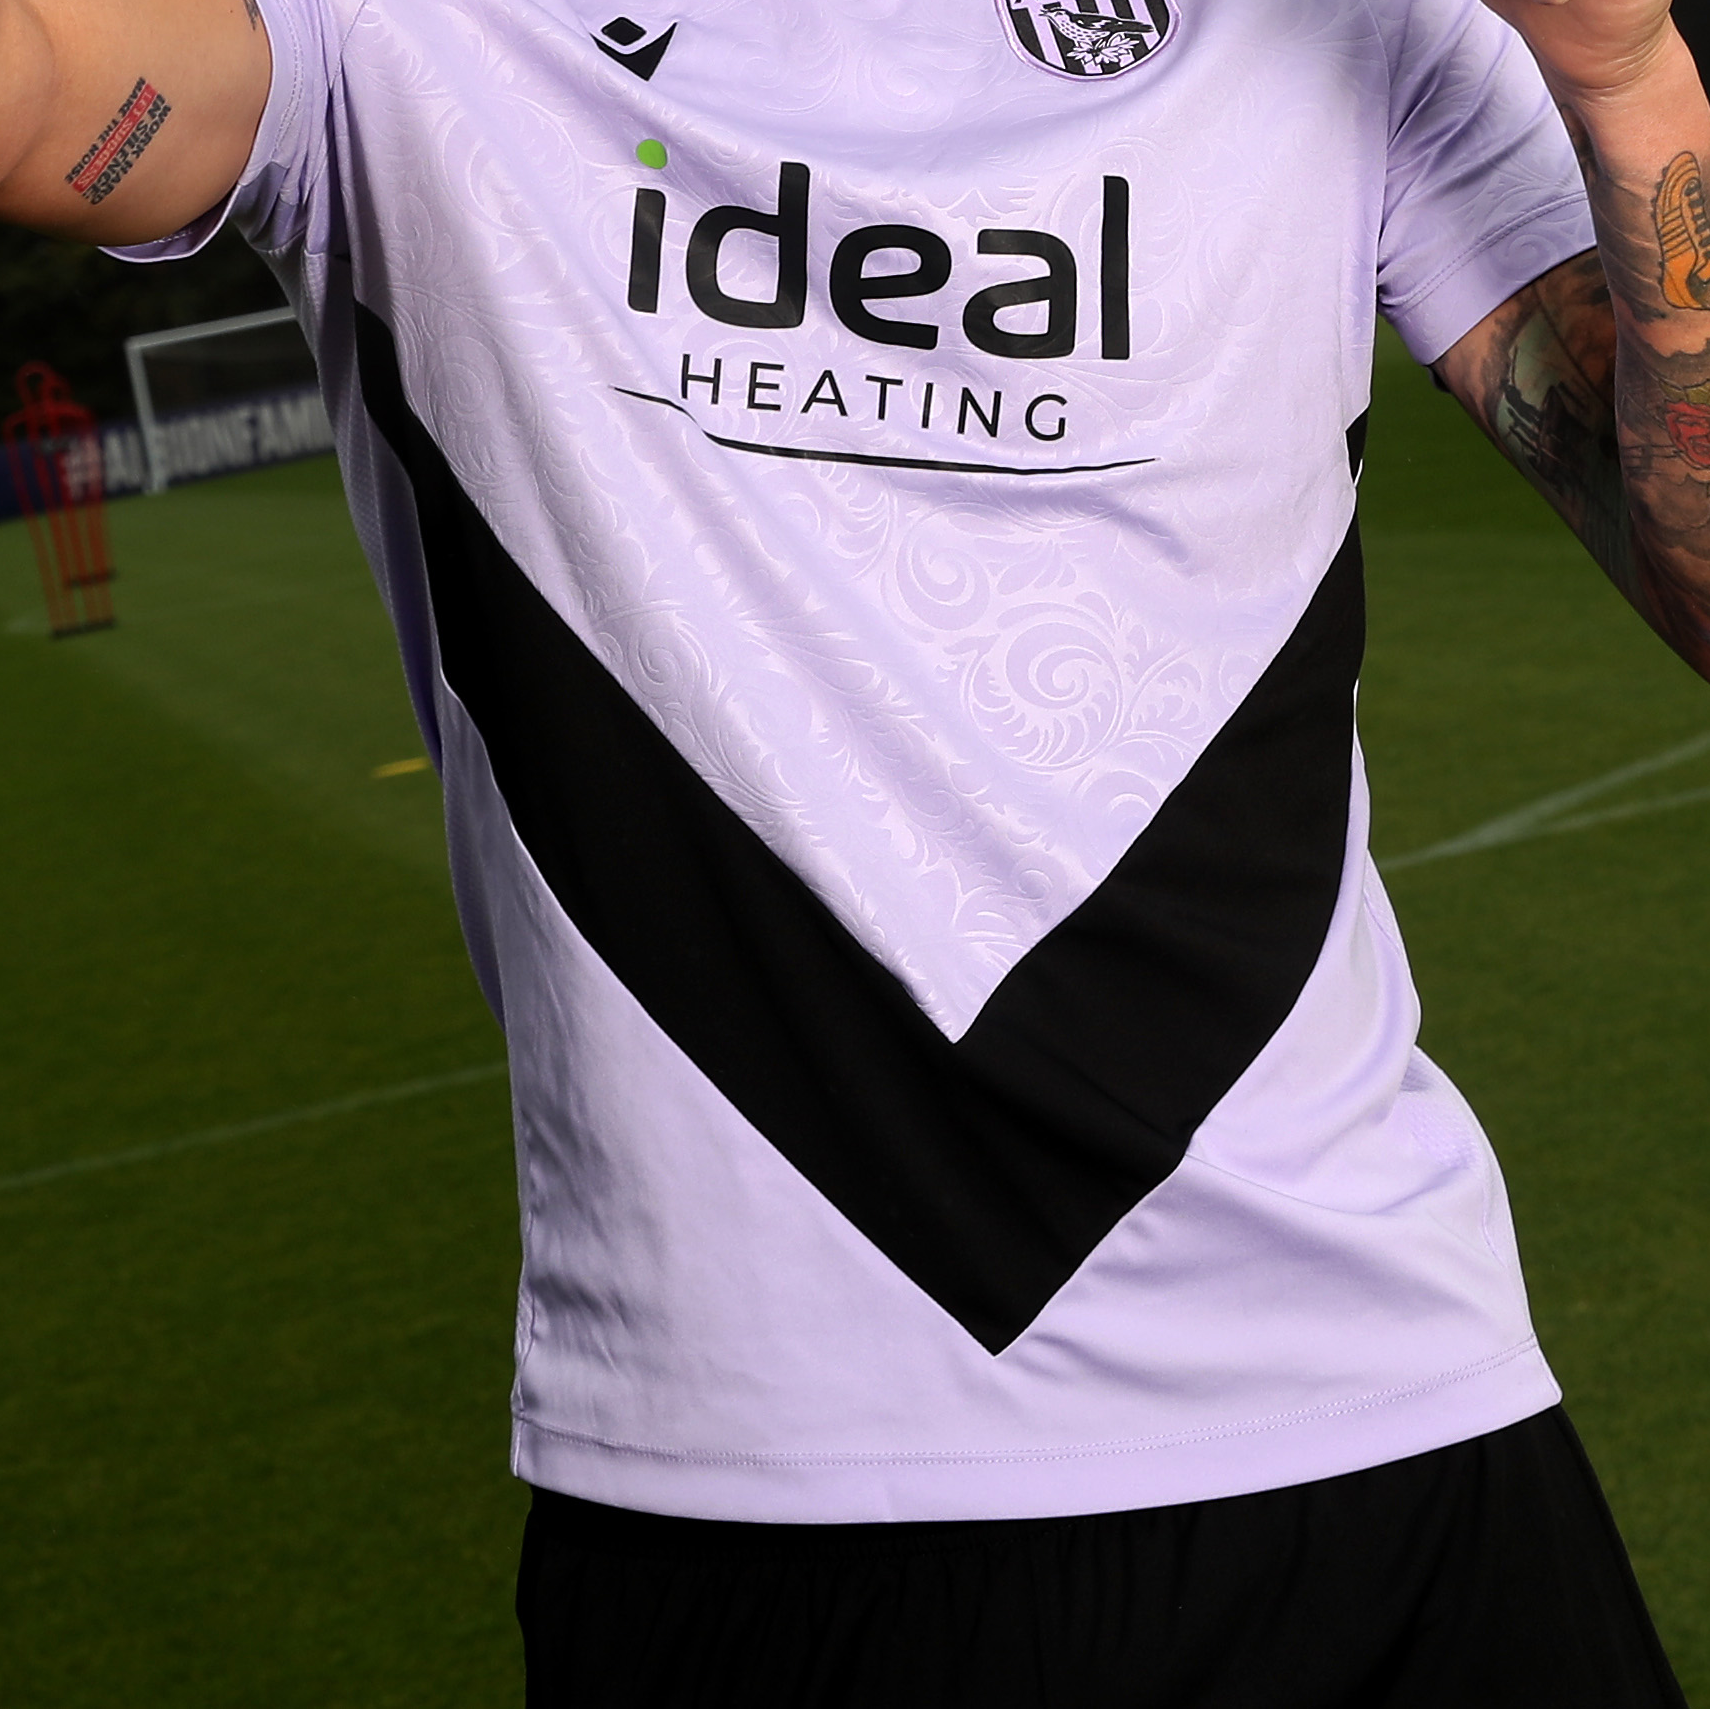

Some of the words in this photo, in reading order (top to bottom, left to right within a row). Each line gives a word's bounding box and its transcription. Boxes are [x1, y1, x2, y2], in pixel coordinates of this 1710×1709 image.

[118, 77, 146, 117] MAKE
[148, 94, 165, 119] IN
[98, 119, 119, 143] THE
[131, 104, 171, 159] WORK
[64, 143, 99, 184] NOISE
[90, 160, 133, 205] HARD
[627, 139, 1130, 360] ideal
[681, 353, 1068, 442] HEATING
